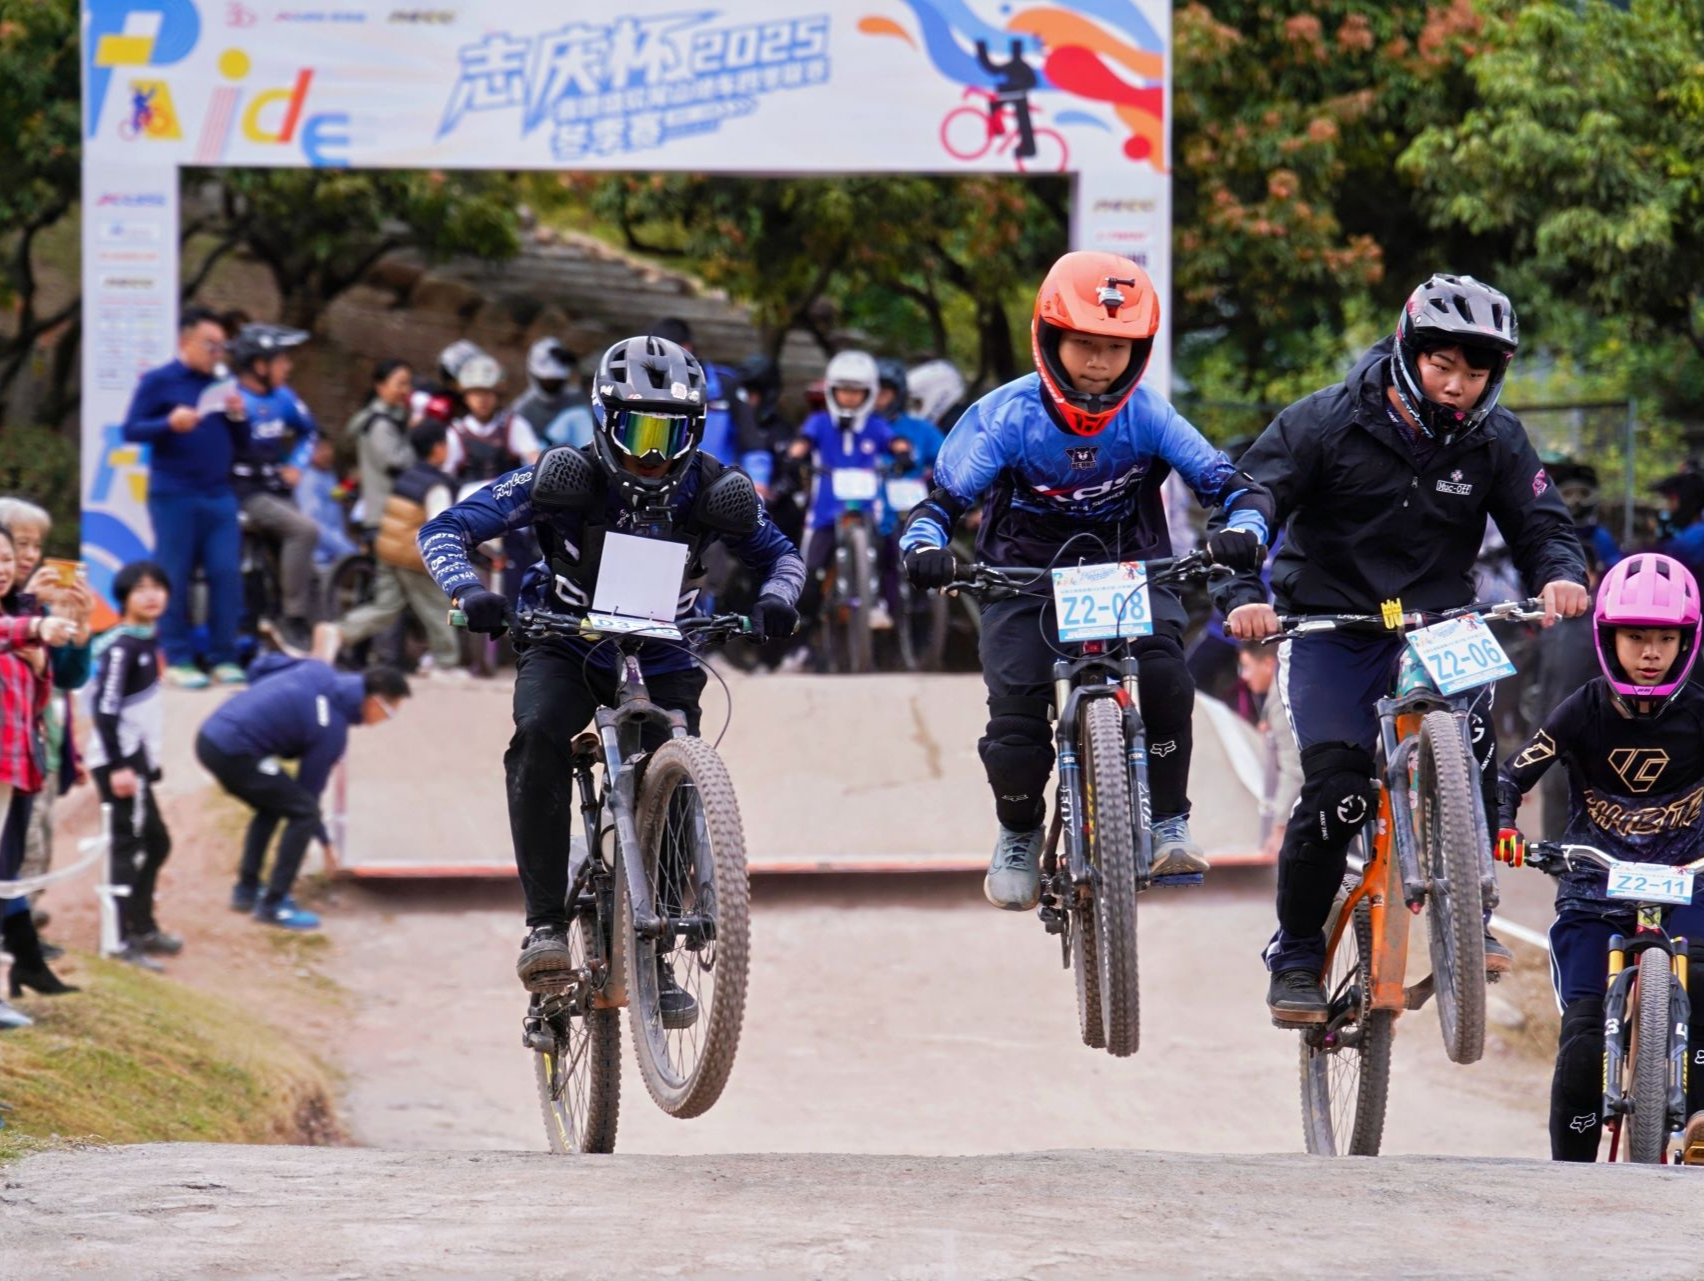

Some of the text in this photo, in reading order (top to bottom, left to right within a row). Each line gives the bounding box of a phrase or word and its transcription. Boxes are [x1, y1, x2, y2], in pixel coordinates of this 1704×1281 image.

[695, 15, 830, 71] 2025
[435, 12, 721, 141] 志庆杯
[1438, 481, 1471, 495] Muc-Off
[1062, 592, 1145, 625] Z2-08
[1427, 639, 1501, 679] Z2-06
[1616, 875, 1685, 895] Z2-11
